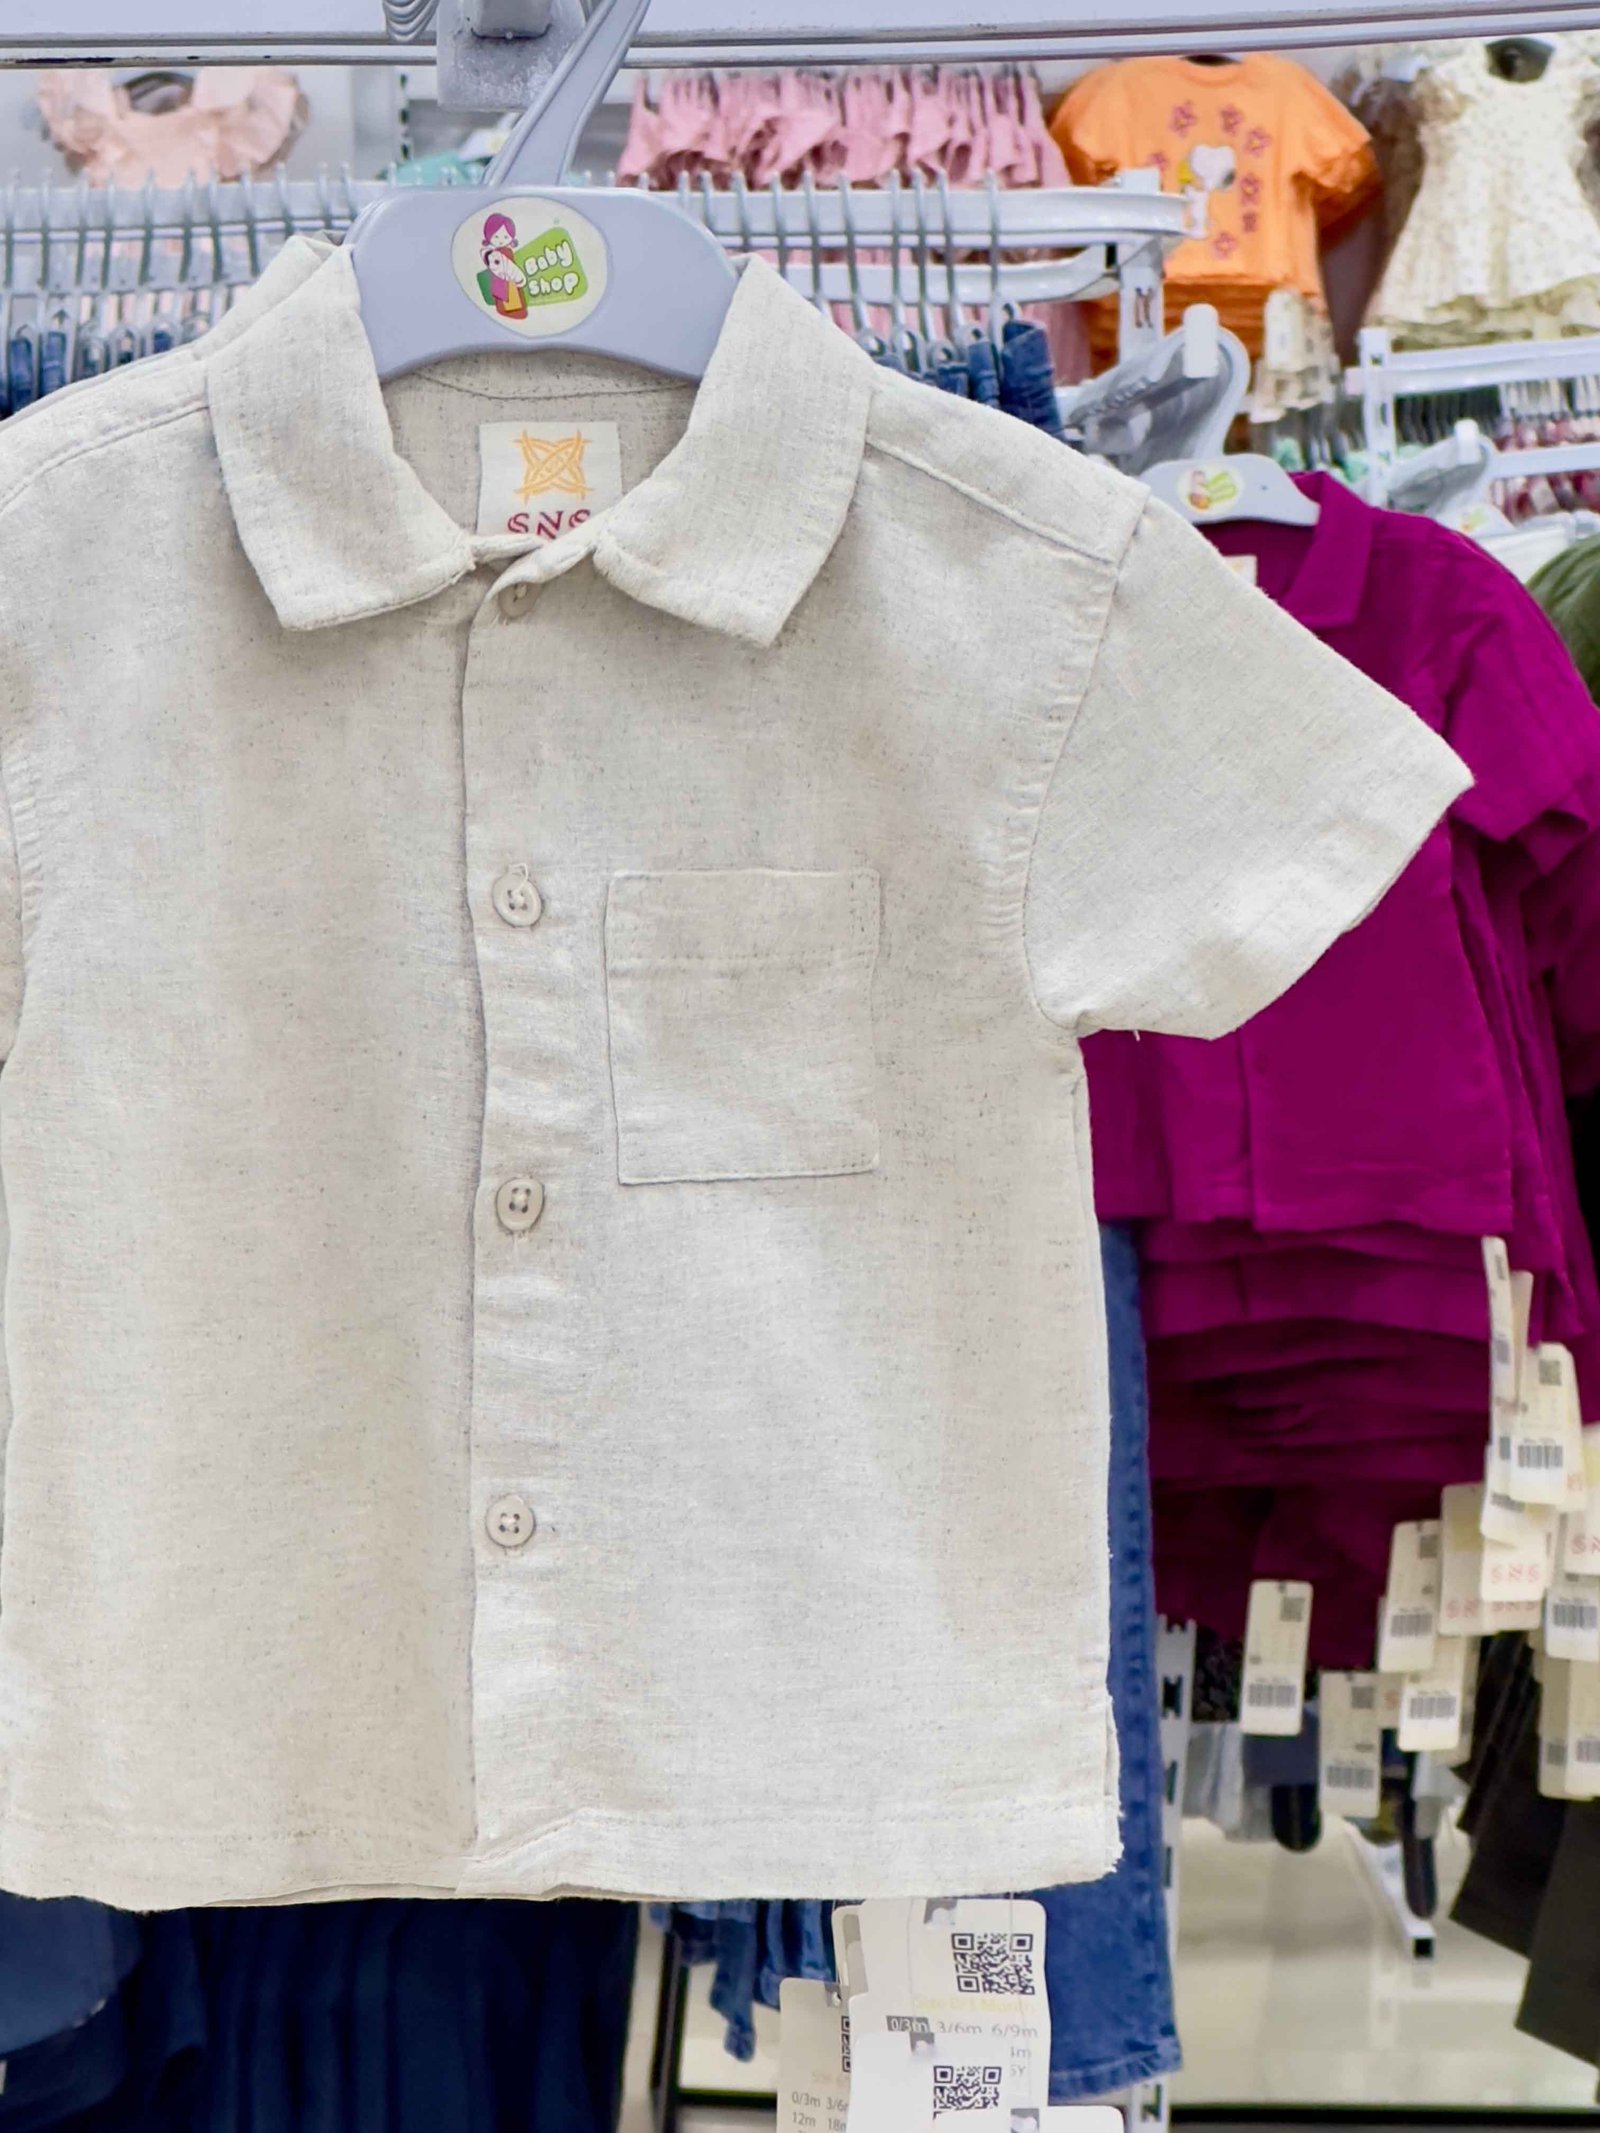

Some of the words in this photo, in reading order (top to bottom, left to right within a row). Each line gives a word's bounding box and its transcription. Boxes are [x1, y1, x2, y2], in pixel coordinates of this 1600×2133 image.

[523, 240, 573, 277] Baby
[936, 2020, 982, 2034] 3/6m
[991, 2023, 1038, 2038] 6/9m
[792, 2091, 821, 2108] 0/3m
[793, 2111, 816, 2127] 12m
